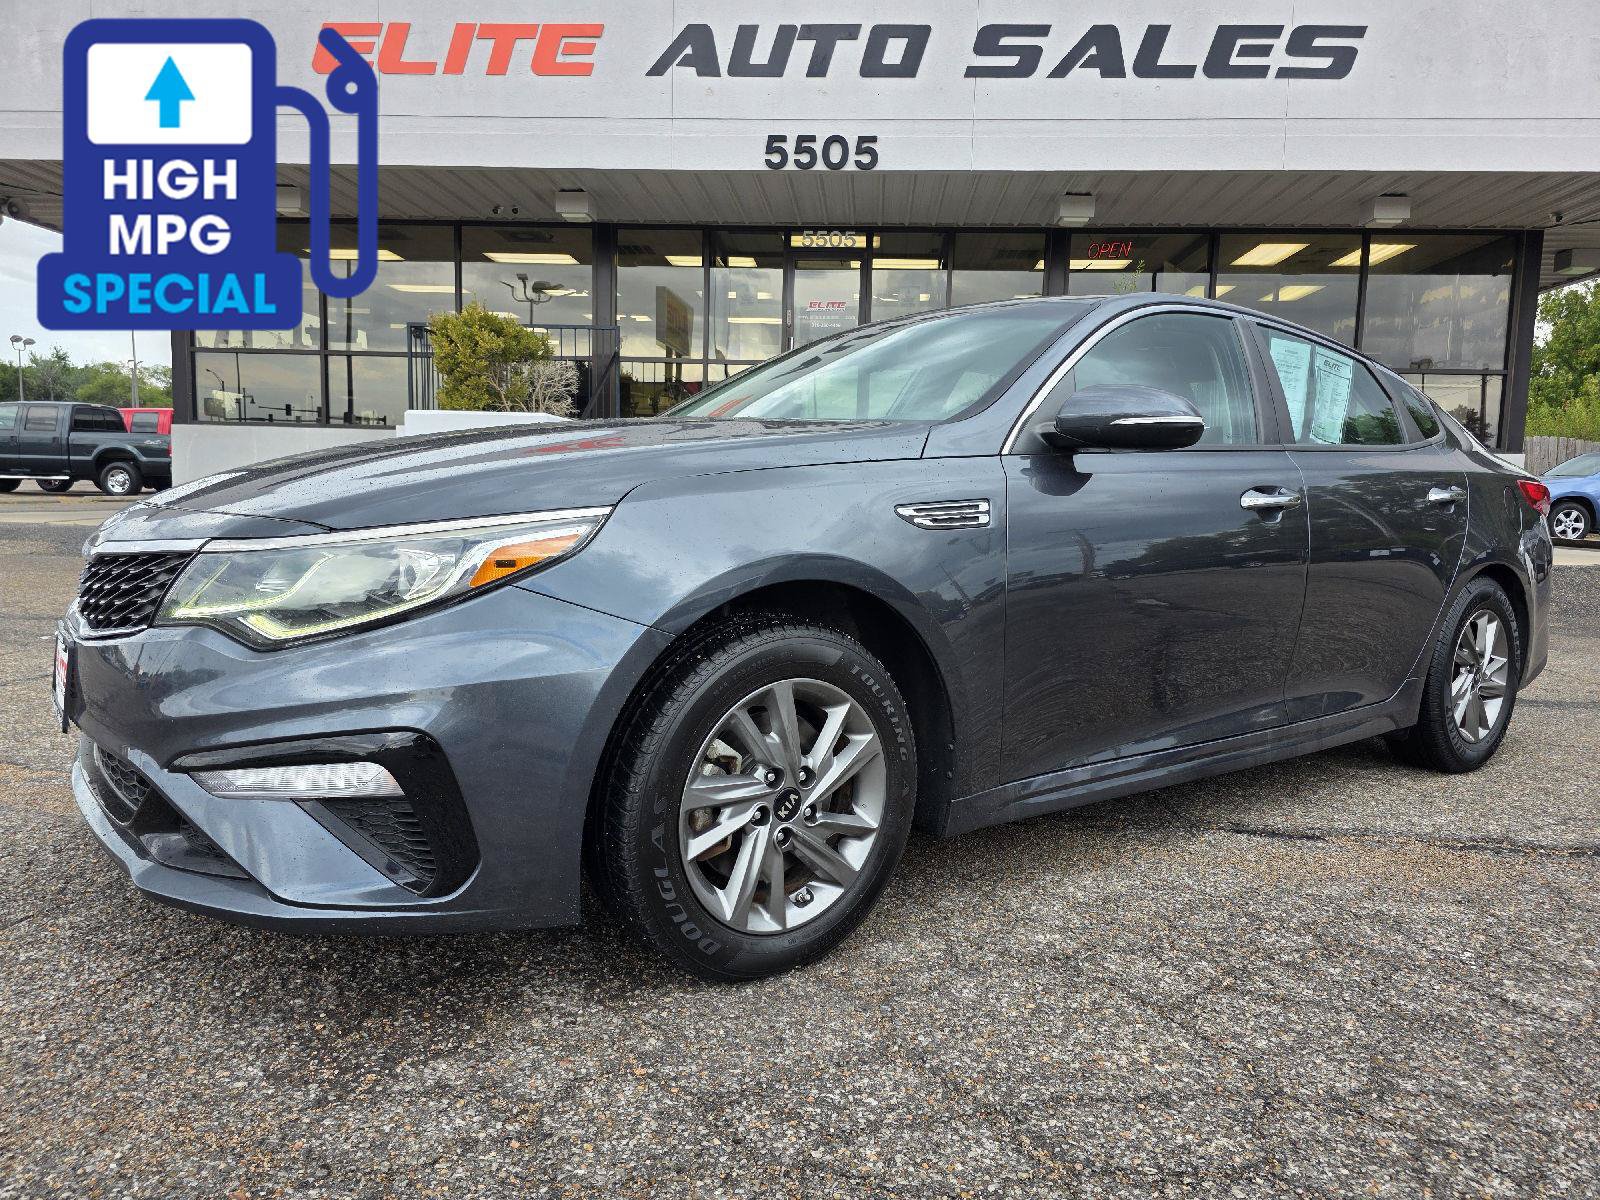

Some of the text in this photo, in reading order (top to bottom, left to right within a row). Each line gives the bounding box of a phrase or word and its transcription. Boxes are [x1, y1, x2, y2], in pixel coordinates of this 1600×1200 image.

[313, 22, 1369, 80] ELITE AUTO SALES
[764, 134, 879, 172] 5505
[801, 230, 857, 248] 5505
[1087, 240, 1134, 259] OPEN
[777, 793, 799, 819] KIA
